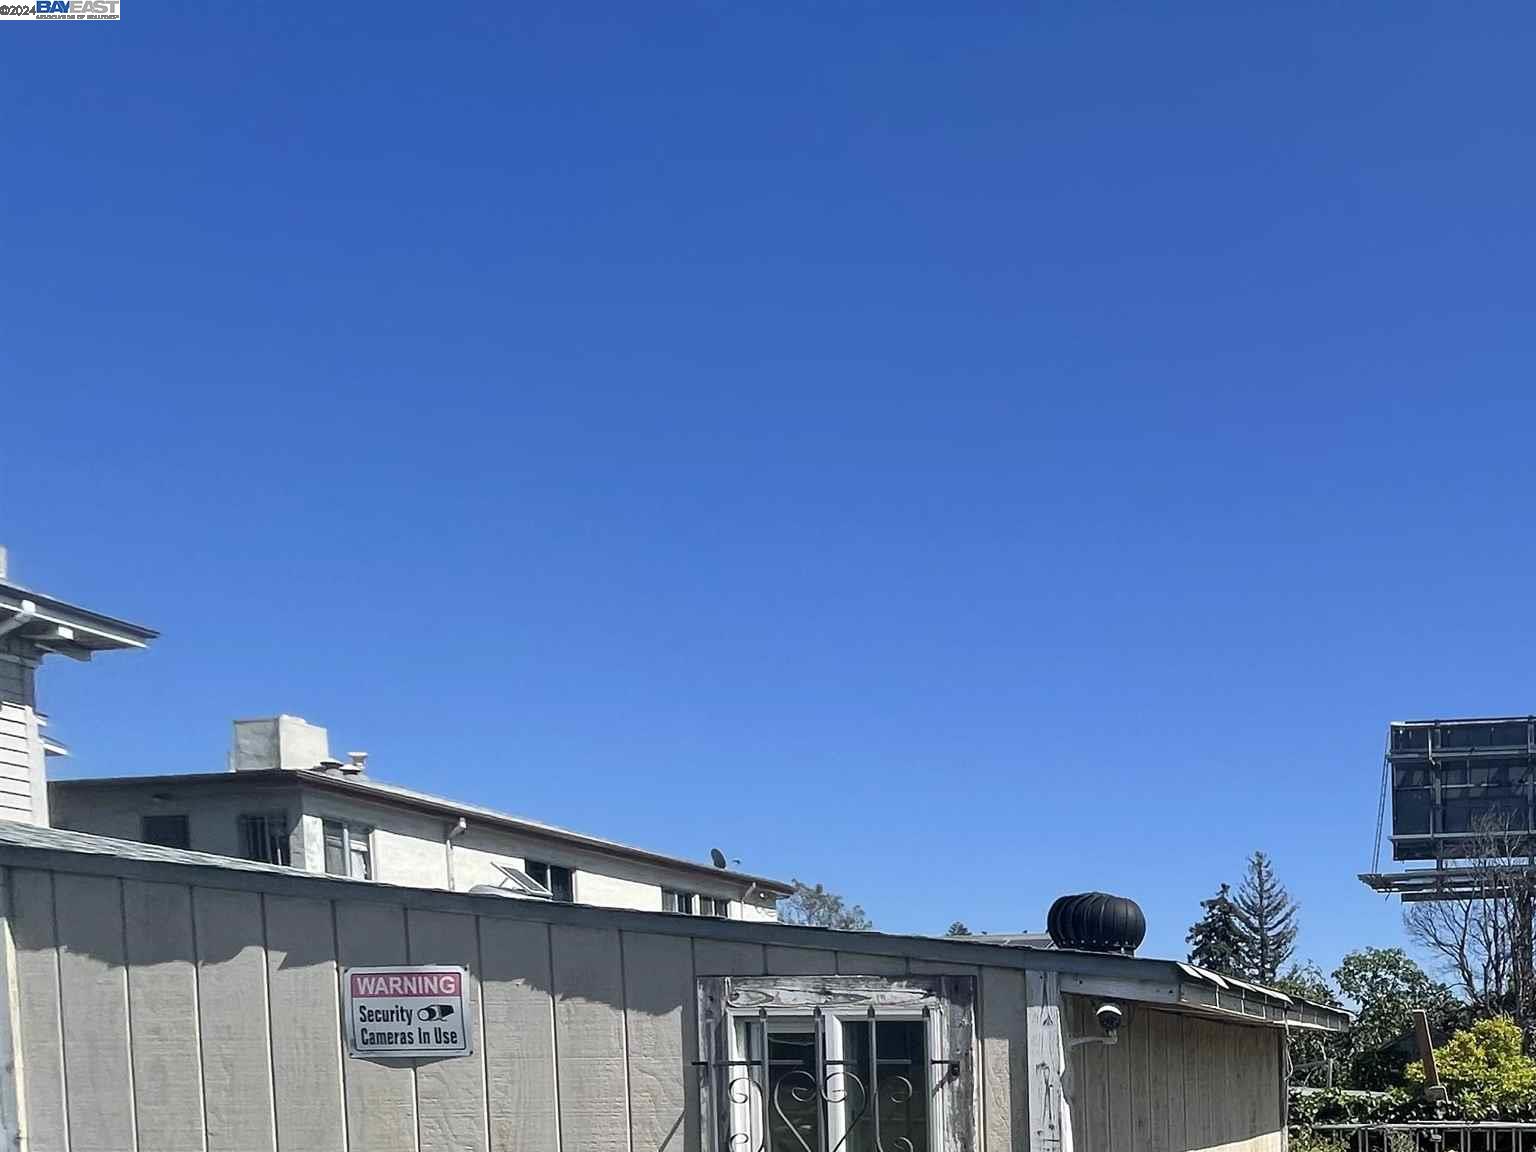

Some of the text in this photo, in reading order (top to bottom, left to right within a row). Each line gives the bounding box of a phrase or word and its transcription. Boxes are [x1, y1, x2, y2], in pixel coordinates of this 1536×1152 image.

[357, 976, 456, 995] WARNING
[359, 1005, 413, 1025] Security
[361, 1028, 414, 1045] Cameras
[434, 1027, 458, 1044] Use
